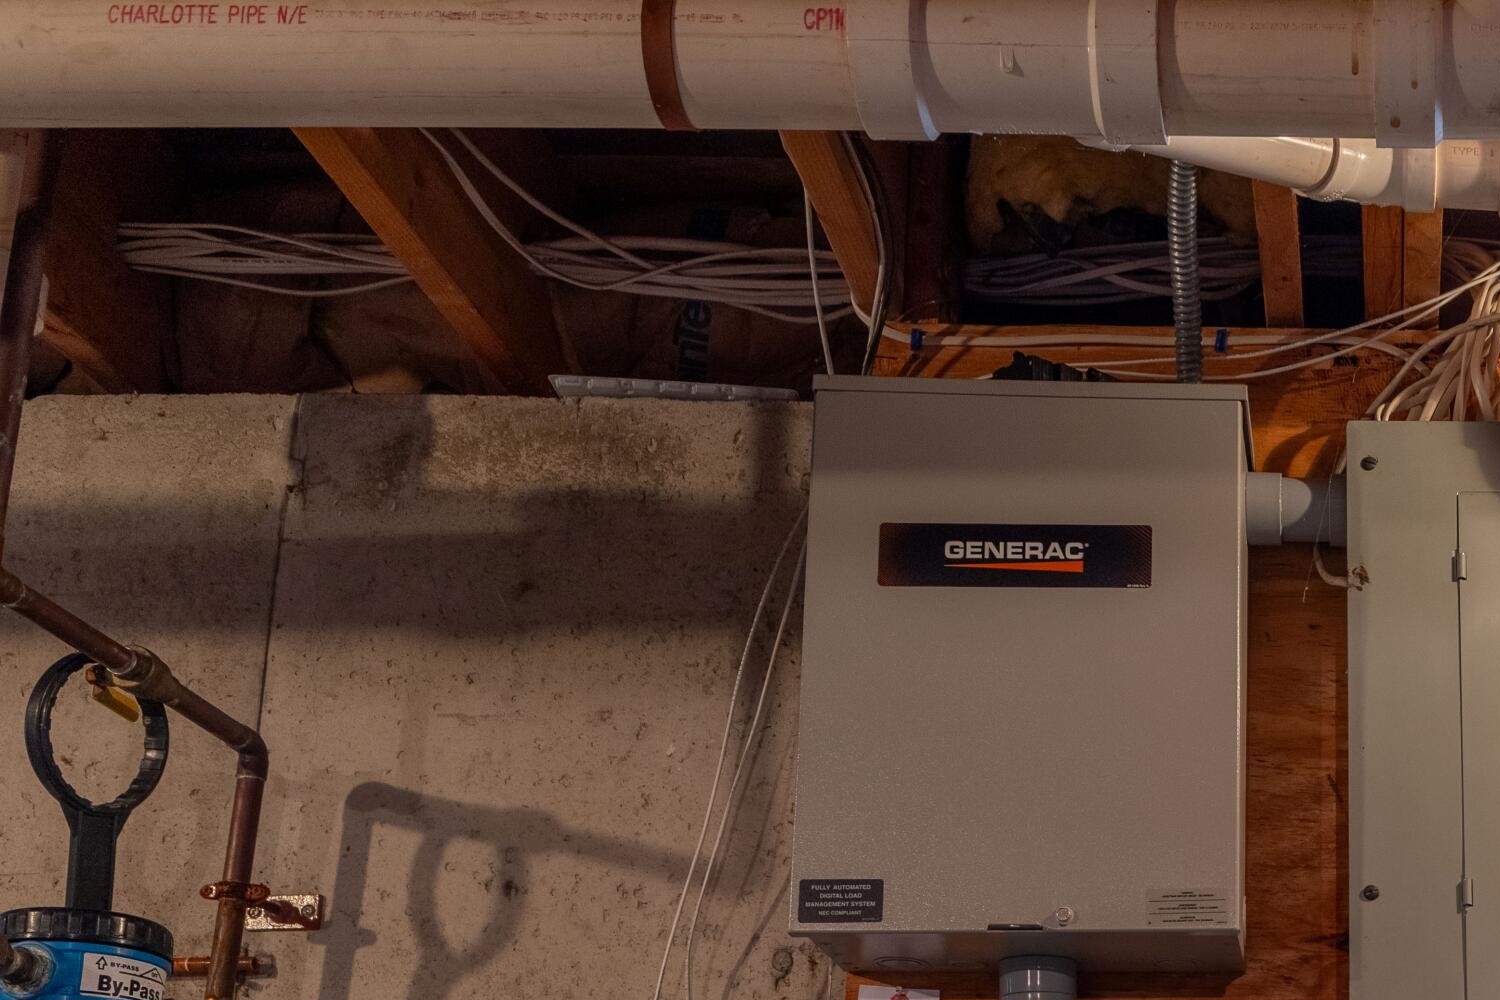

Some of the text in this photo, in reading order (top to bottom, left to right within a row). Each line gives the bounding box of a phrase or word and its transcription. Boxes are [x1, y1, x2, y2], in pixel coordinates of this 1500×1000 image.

[108, 4, 219, 24] CHARLOTTE
[228, 5, 268, 24] PIPE
[277, 5, 308, 25] N/E
[944, 541, 1084, 560] GENERAC
[110, 961, 139, 972] BY-PASS
